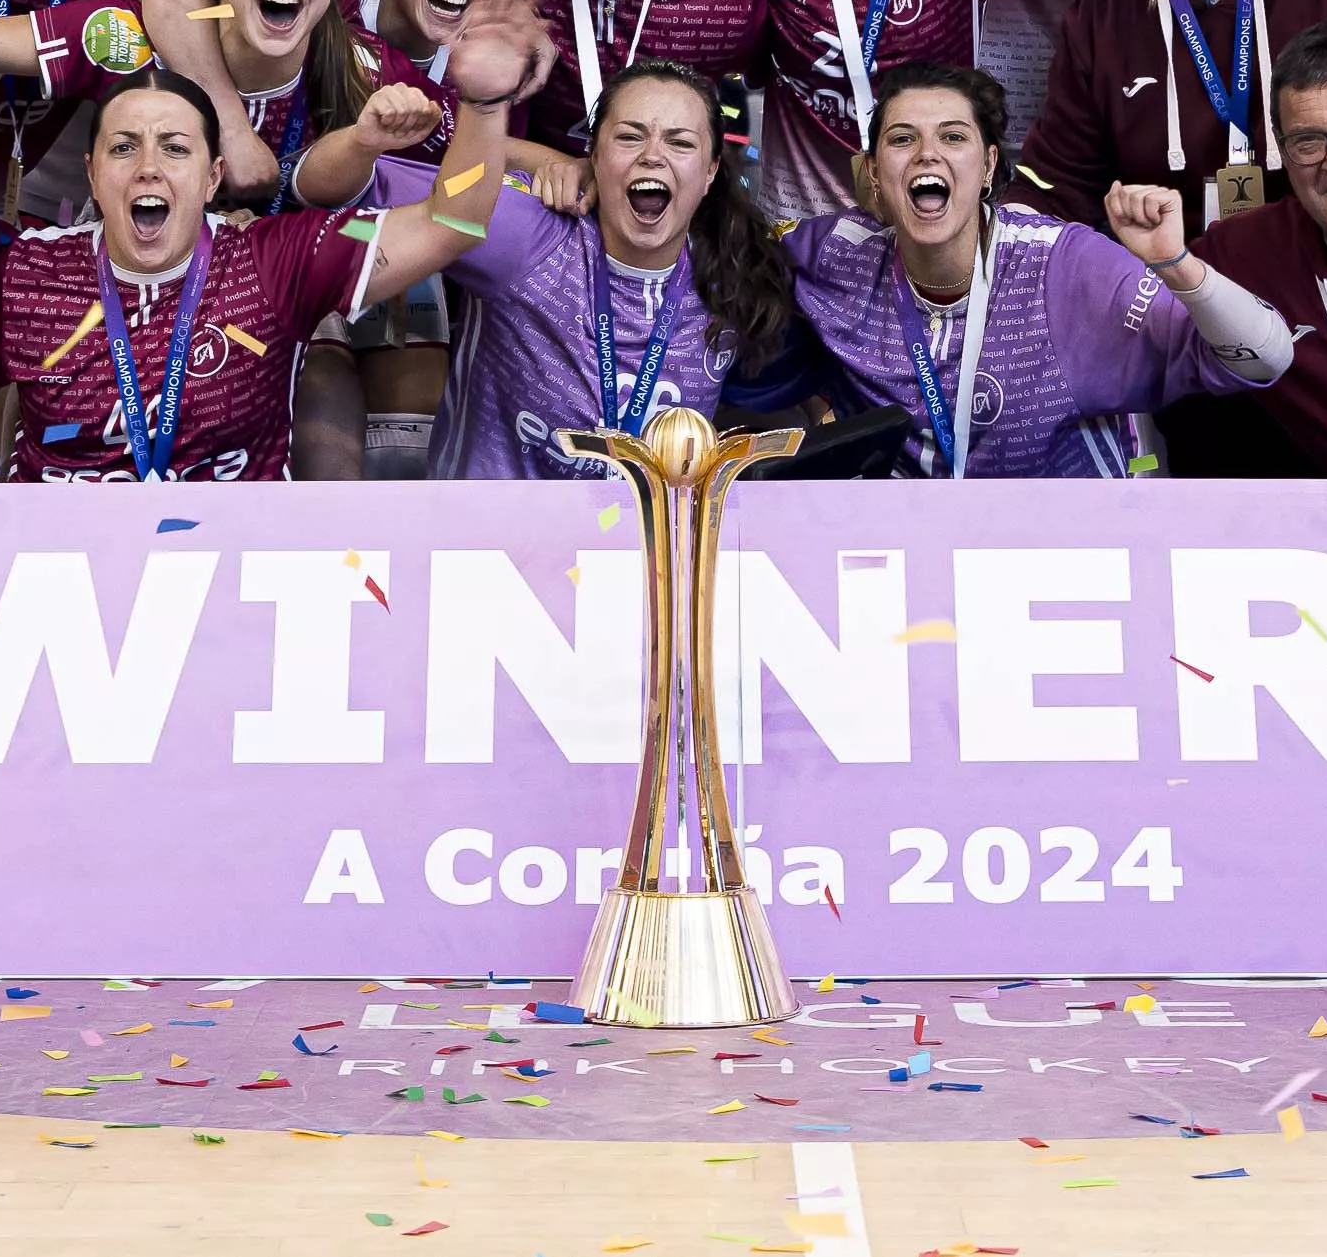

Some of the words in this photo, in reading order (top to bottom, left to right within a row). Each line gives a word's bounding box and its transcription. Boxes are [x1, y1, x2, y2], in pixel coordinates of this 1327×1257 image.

[526, 276, 541, 292] Fran
[225, 290, 251, 303] Andrea
[1008, 286, 1035, 296] Andrea
[42, 294, 61, 302] Angie
[61, 308, 83, 317] Xavier
[996, 317, 1025, 327] Patricia
[566, 326, 584, 342] Carla
[616, 329, 634, 337] Meri
[631, 299, 676, 417] CHAMPIONSLEAGUE
[833, 346, 861, 363] Marcela
[866, 360, 890, 372] Sandra
[885, 352, 908, 362] Pepita
[161, 311, 193, 435] CHAMPIONSLEAGUE
[989, 362, 1005, 372] Adri
[185, 377, 211, 389] Miquel
[1034, 385, 1056, 395] Paula
[303, 829, 385, 904] A
[888, 826, 1184, 904] 2024
[358, 1000, 1247, 1029] LEGUE
[338, 1058, 649, 1077] RINK
[720, 1056, 1278, 1077] HOCKEY
